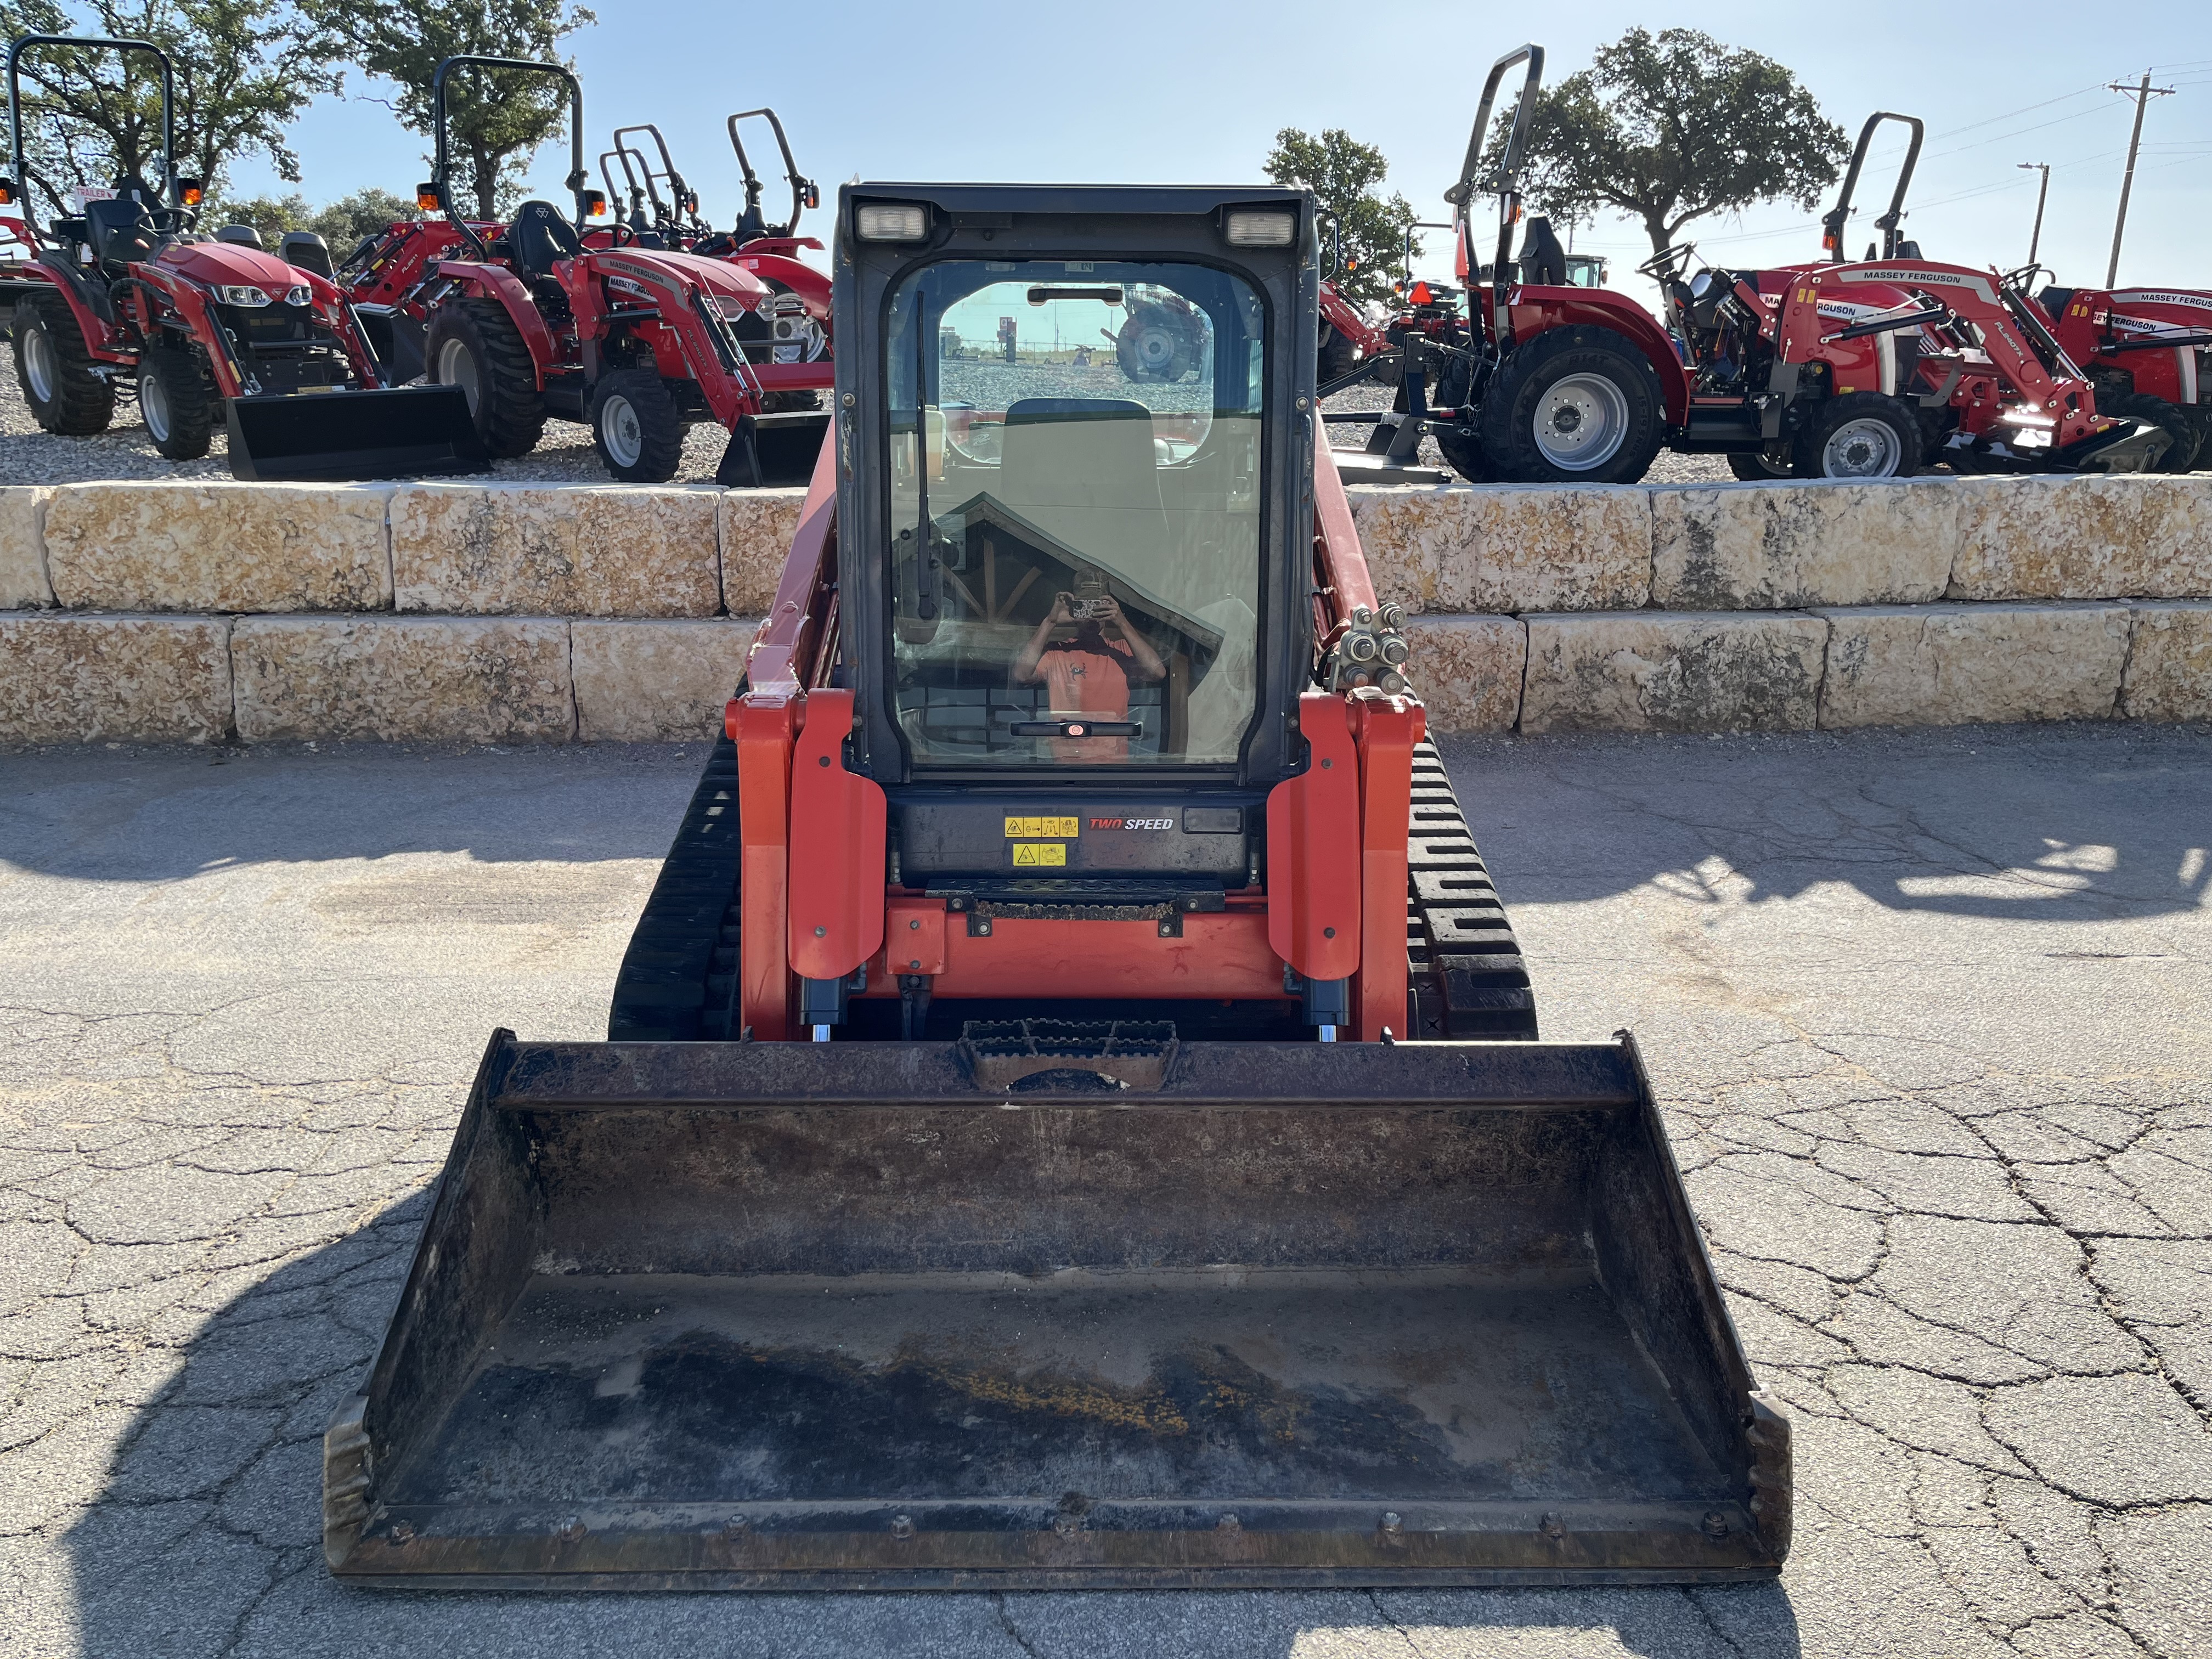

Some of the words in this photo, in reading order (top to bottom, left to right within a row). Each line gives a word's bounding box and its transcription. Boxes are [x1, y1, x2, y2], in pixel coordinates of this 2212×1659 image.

[77, 188, 105, 198] TRAILER
[610, 261, 633, 272] MASSEY
[634, 267, 664, 284] FERGUSON
[1908, 273, 1961, 283] FERGUSON
[610, 278, 631, 289] MASSEY
[2141, 294, 2177, 302] MASSEY
[2111, 317, 2157, 331] FERGUSON
[1994, 321, 2024, 357] FL2407X
[1090, 819, 1123, 830] TWO
[1125, 819, 1173, 830] SPEED
